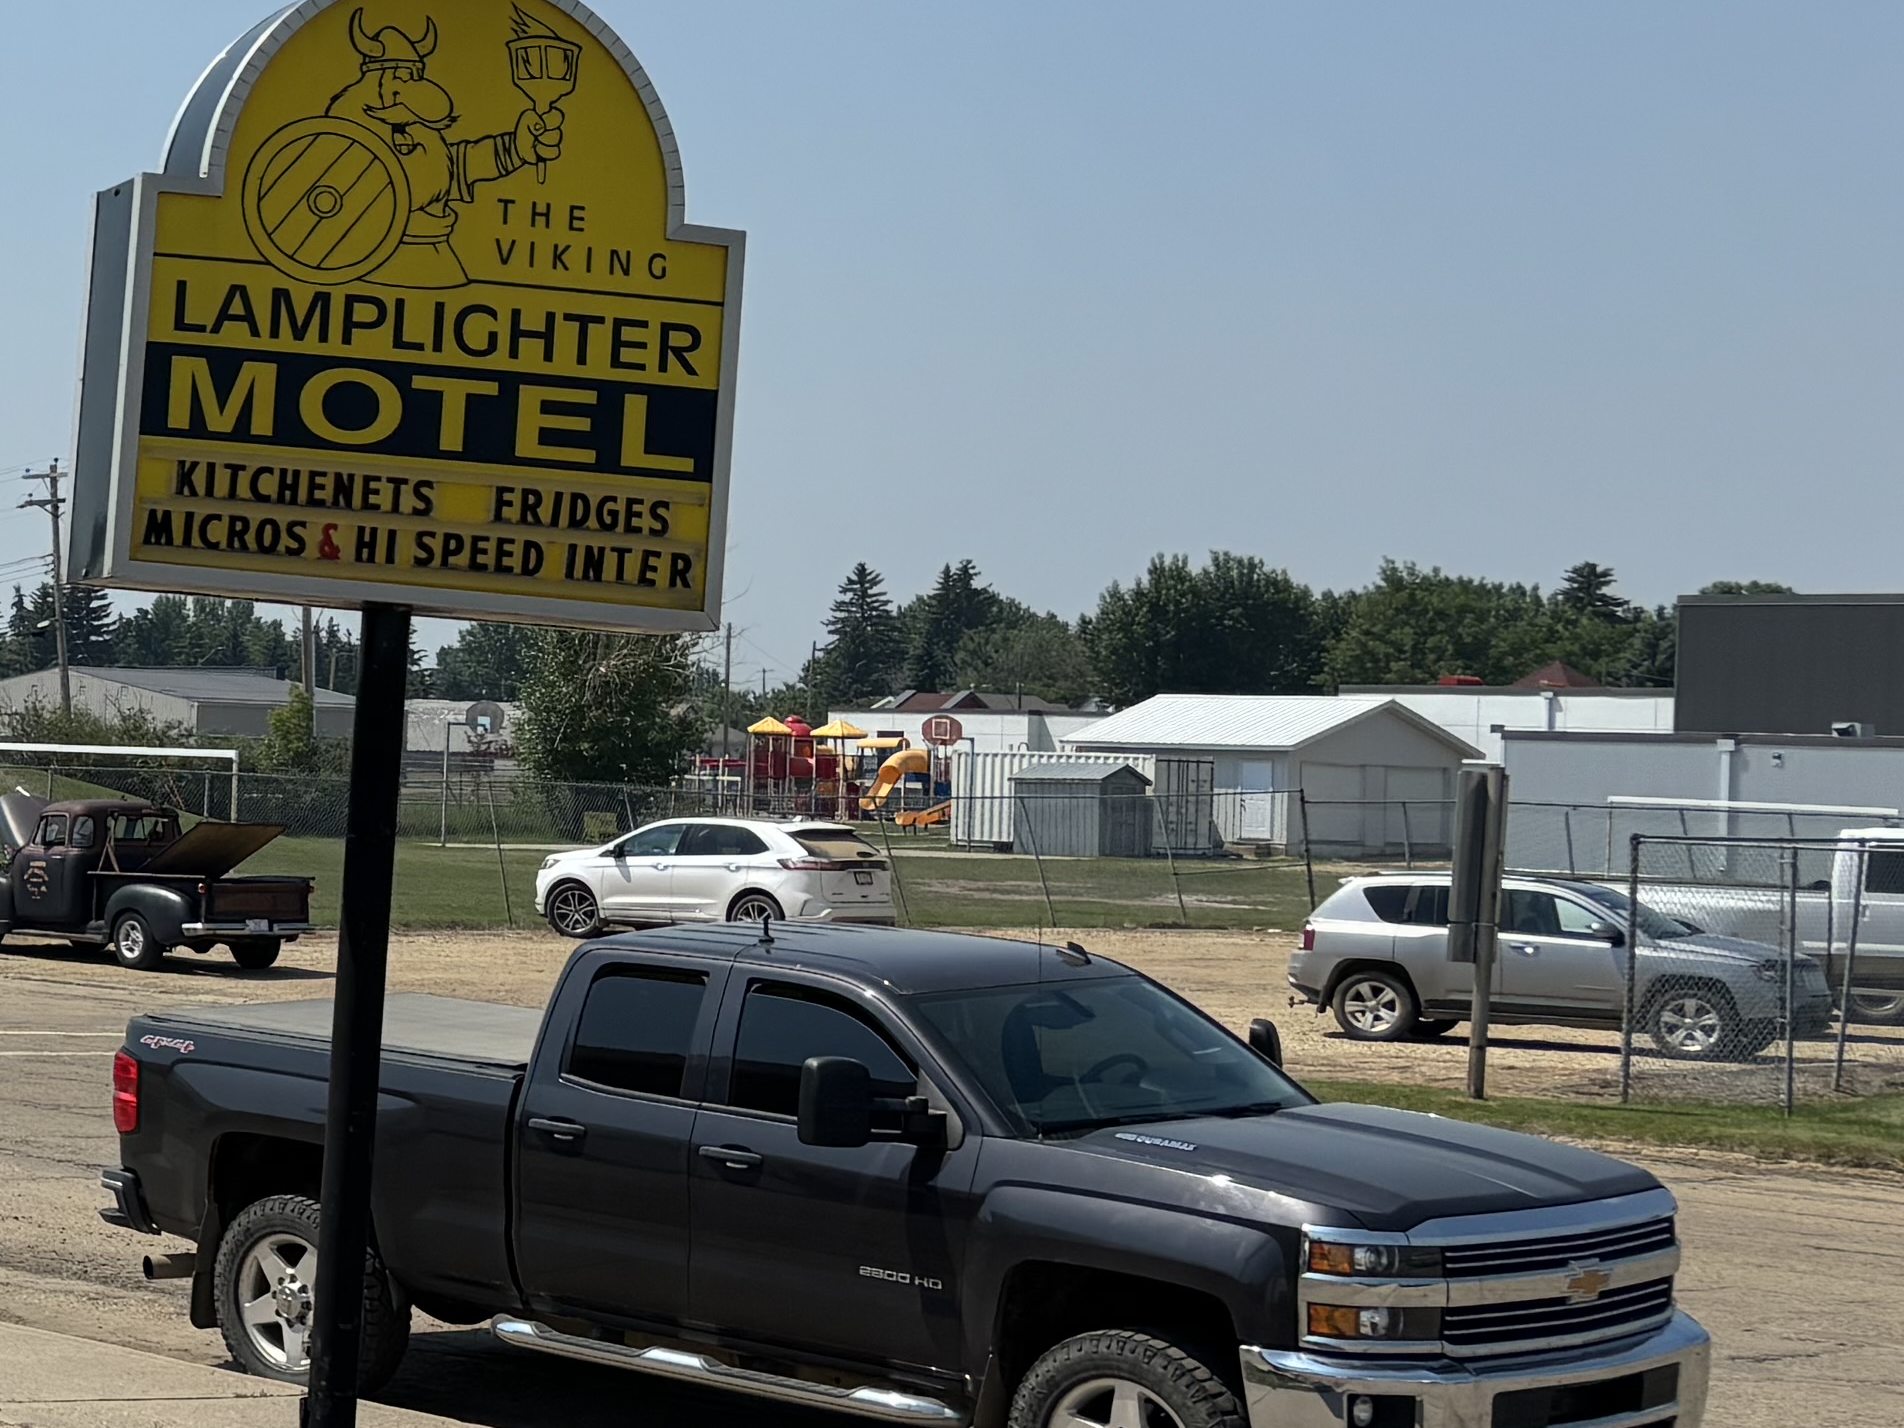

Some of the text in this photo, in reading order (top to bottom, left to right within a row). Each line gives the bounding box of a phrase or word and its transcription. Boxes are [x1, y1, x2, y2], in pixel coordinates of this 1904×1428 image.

[497, 198, 586, 232] THE
[495, 237, 668, 280] VIKING
[173, 279, 703, 377] LAMPLIGHTER
[167, 355, 695, 474] MOTEL
[175, 459, 671, 538] KITCHENETS FRIDGES
[143, 508, 693, 589] MICROS & HI SPEED INTER
